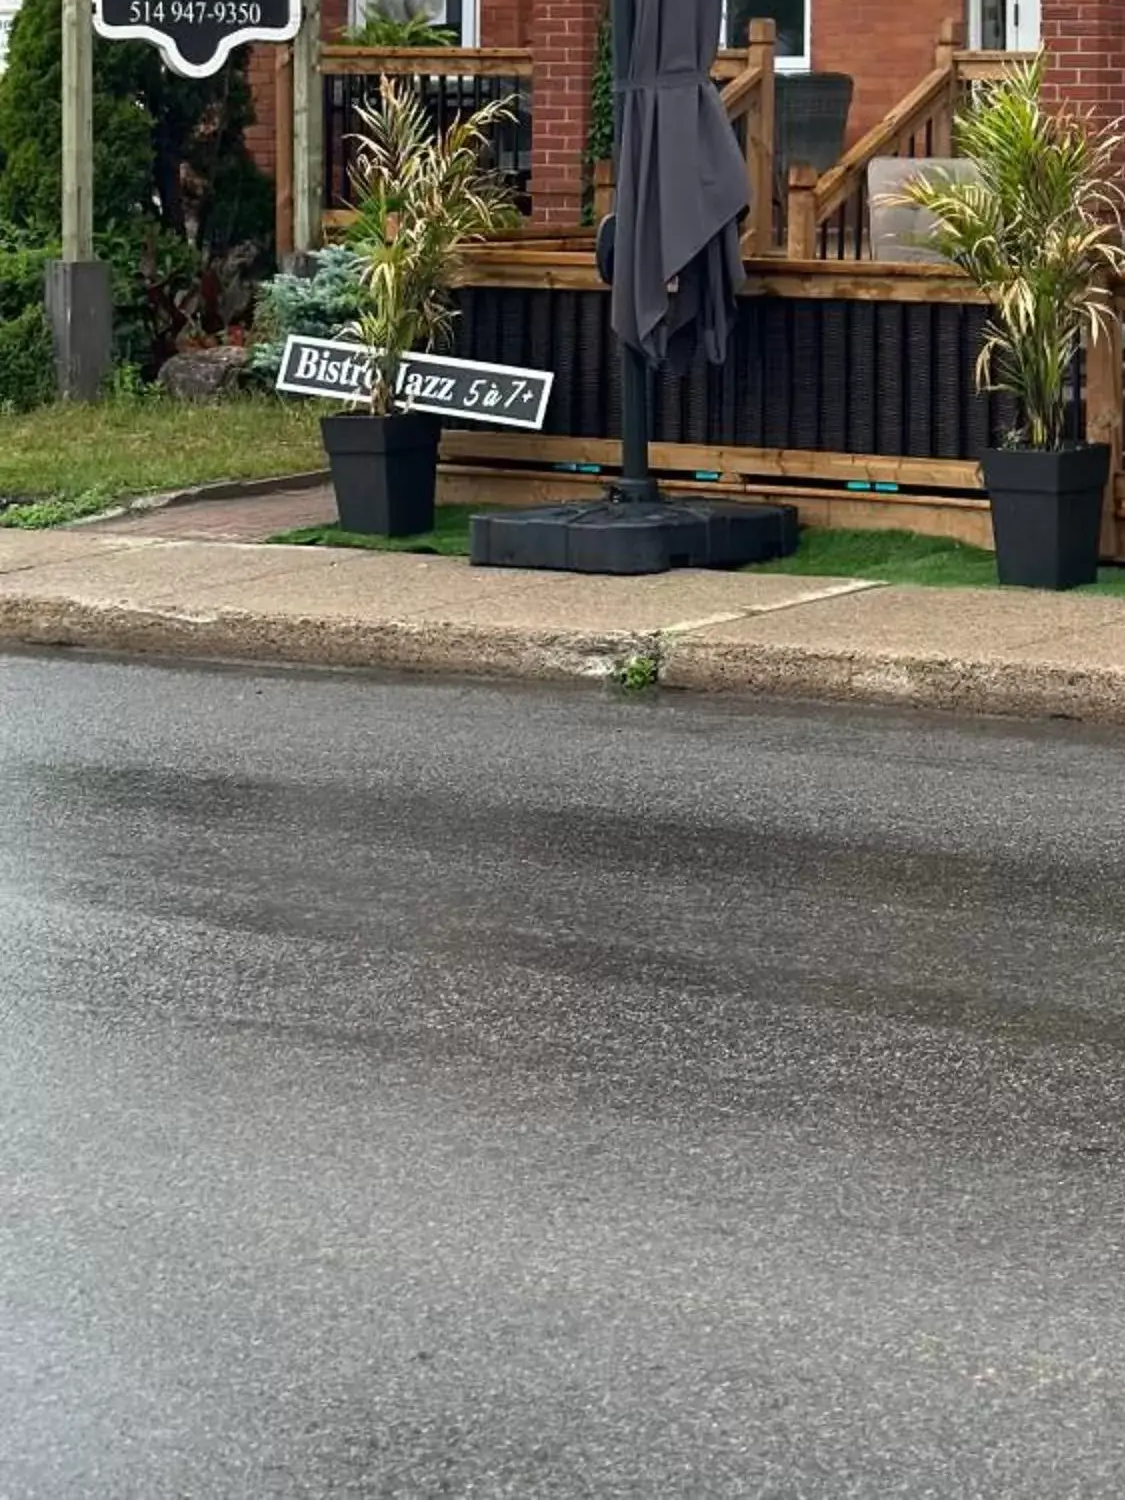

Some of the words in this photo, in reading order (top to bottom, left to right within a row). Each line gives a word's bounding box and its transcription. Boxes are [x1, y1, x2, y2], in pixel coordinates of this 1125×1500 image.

[129, 2, 165, 24] 514
[171, 1, 261, 24] 947-9350
[294, 347, 383, 389] Bistro
[463, 379, 487, 407] 5
